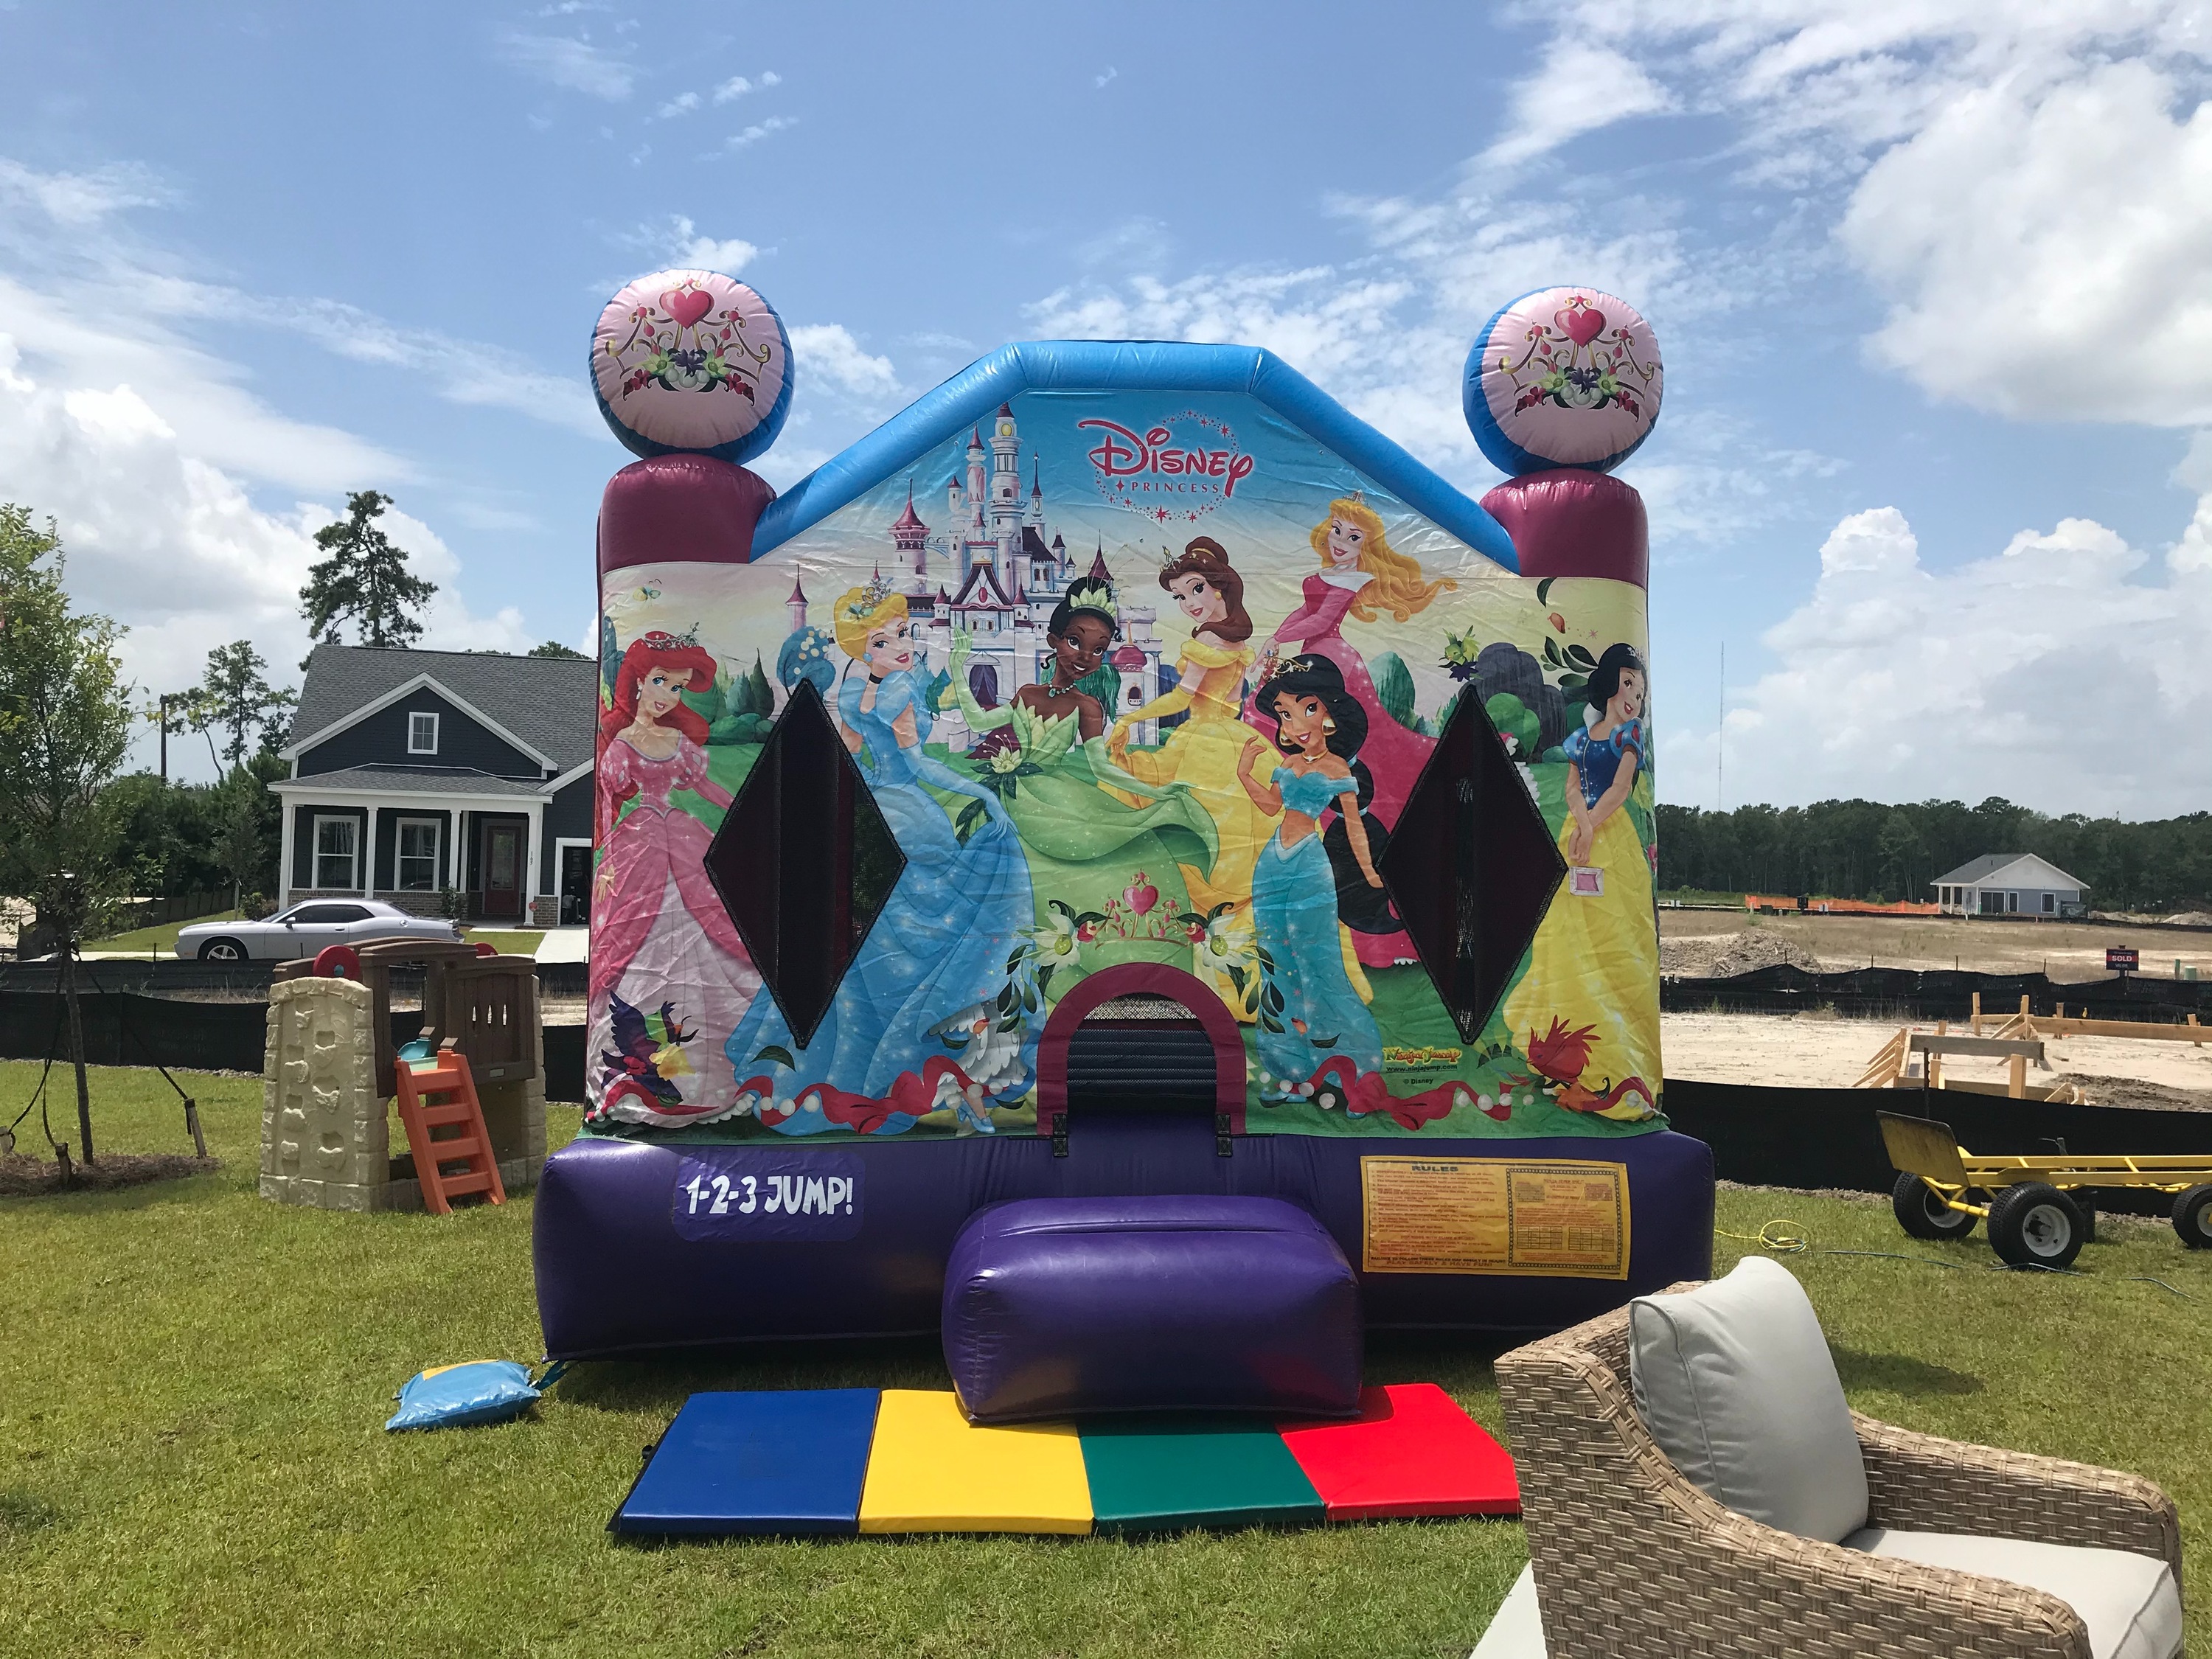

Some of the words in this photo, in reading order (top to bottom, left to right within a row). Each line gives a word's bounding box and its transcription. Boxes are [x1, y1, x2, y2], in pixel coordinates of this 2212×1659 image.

[1132, 481, 1218, 493] PRINCESS
[686, 1174, 757, 1214] 1-2-3
[765, 1175, 854, 1215] JUMP!
